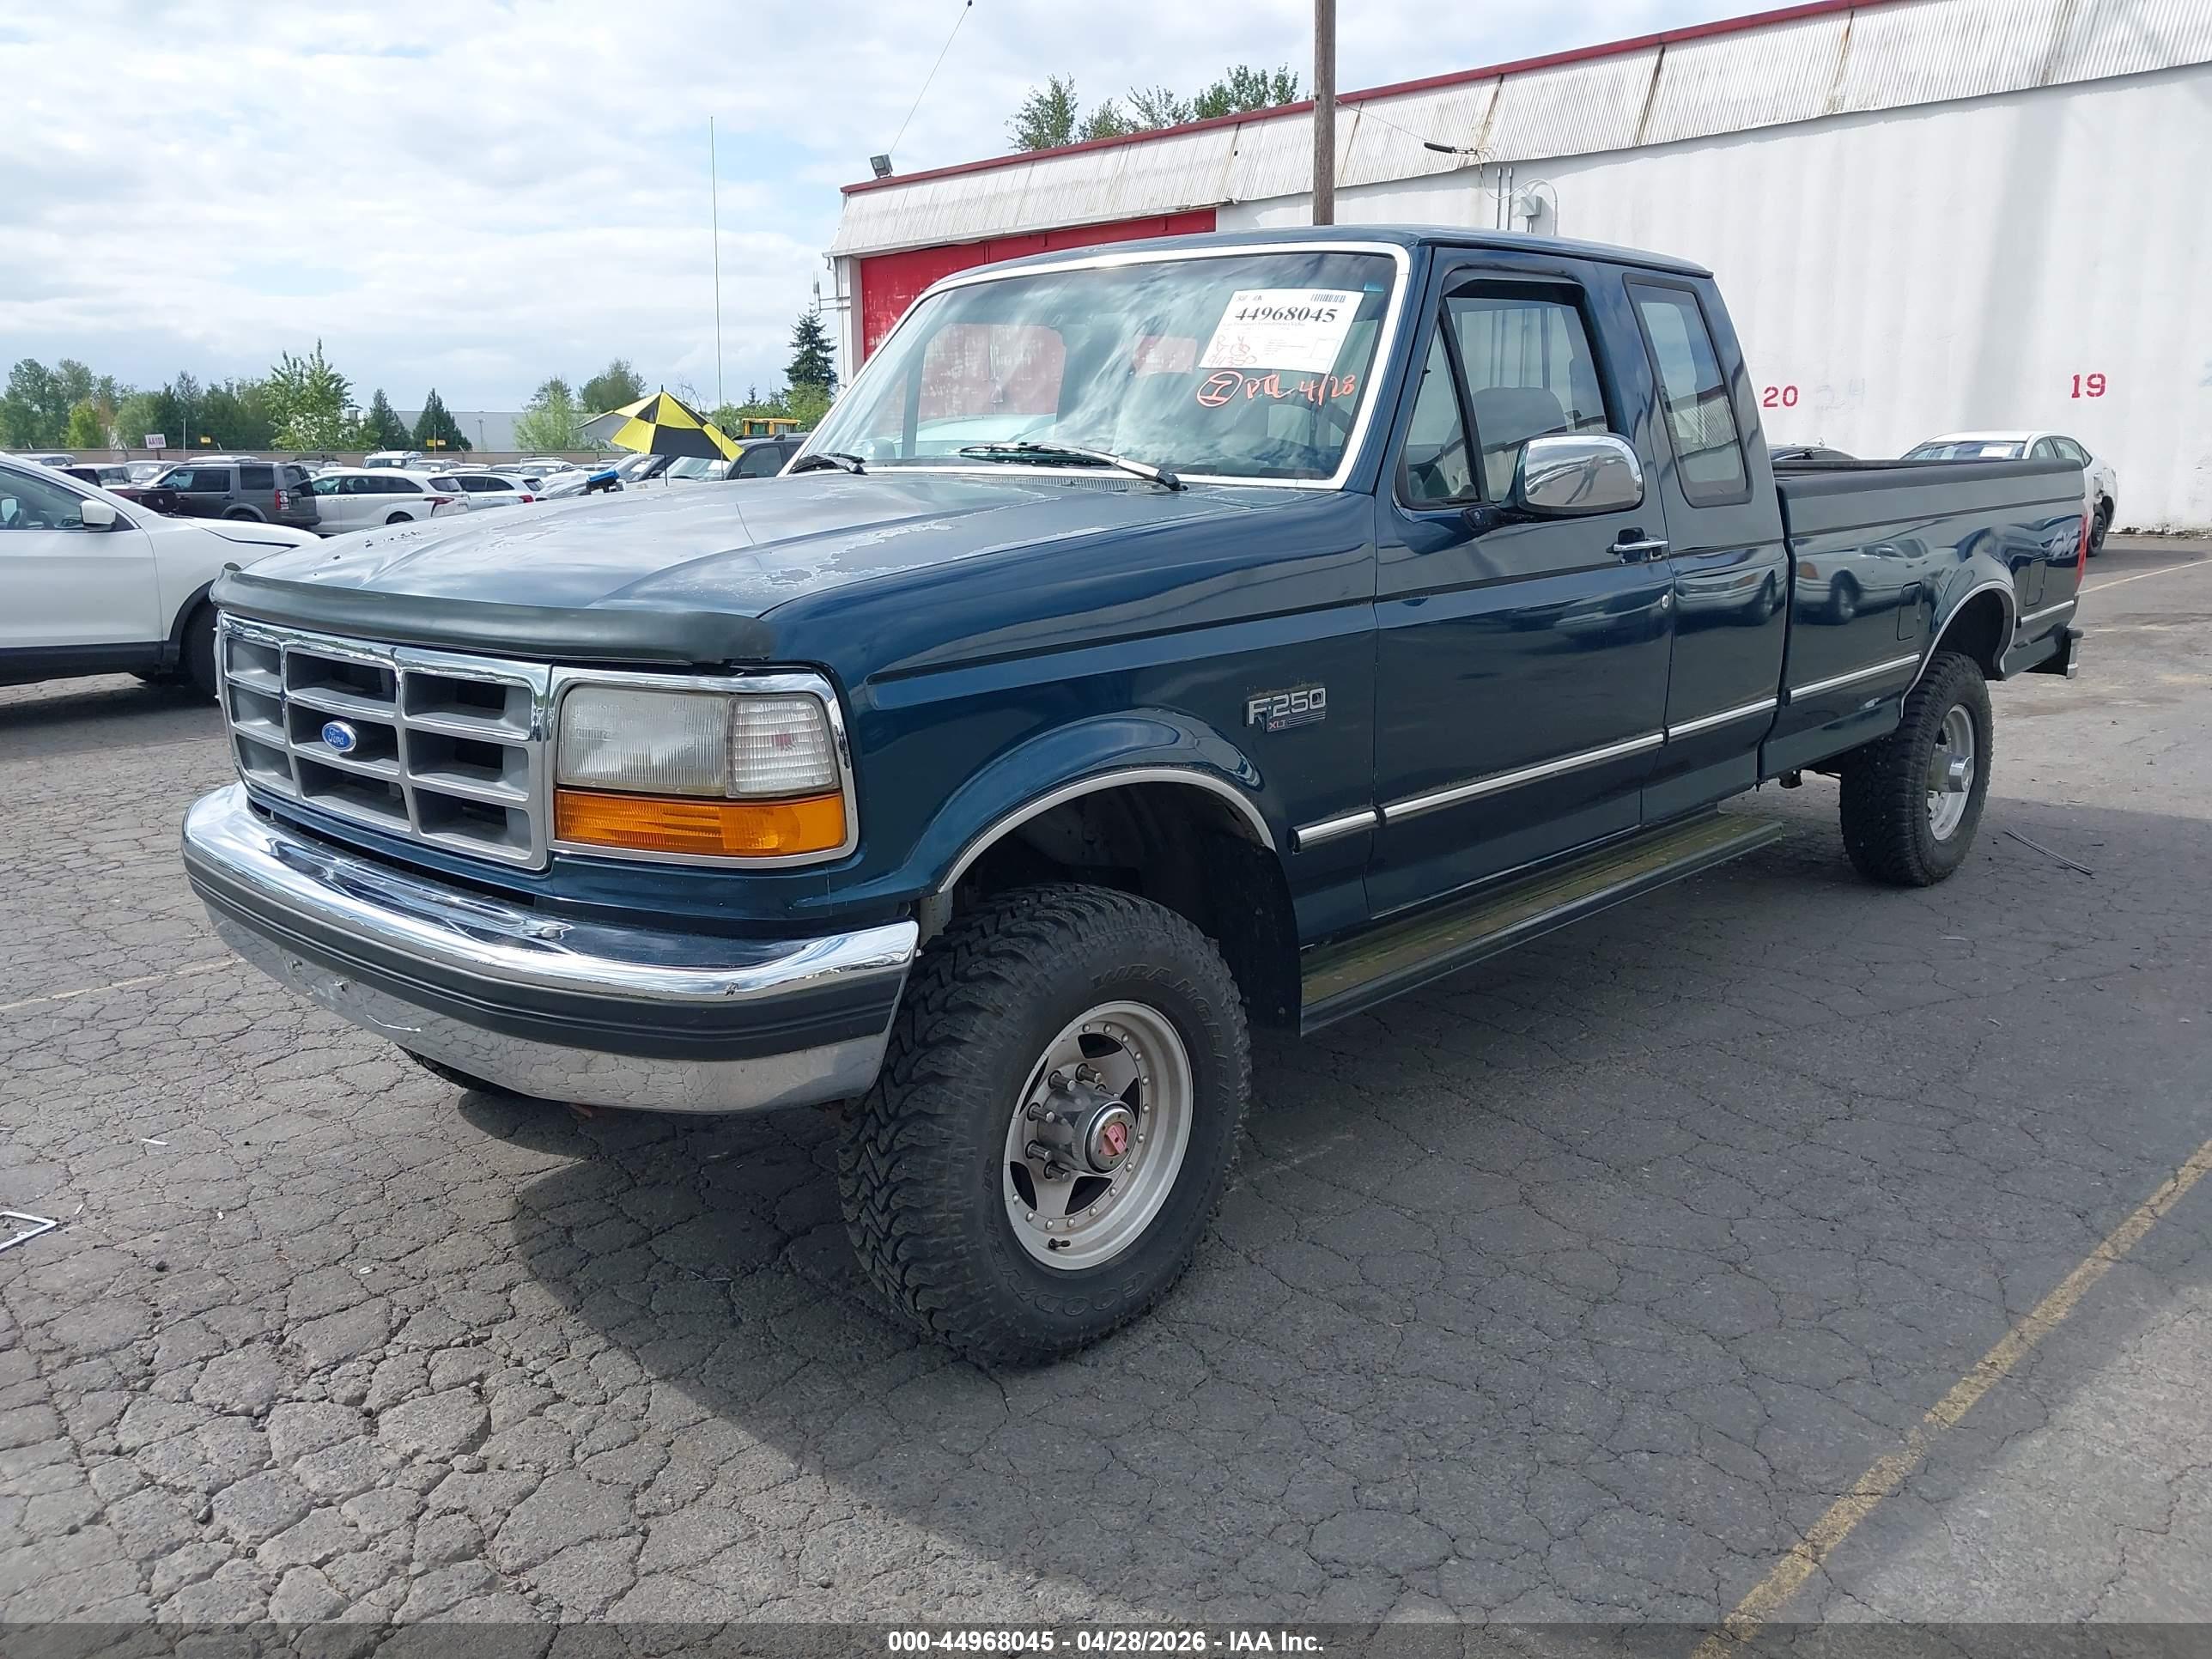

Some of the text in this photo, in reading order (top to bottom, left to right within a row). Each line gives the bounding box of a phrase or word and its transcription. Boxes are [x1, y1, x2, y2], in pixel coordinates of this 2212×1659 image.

[1235, 307, 1338, 323] 44968045
[1763, 385, 1798, 408] 20
[2070, 372, 2106, 398] 19
